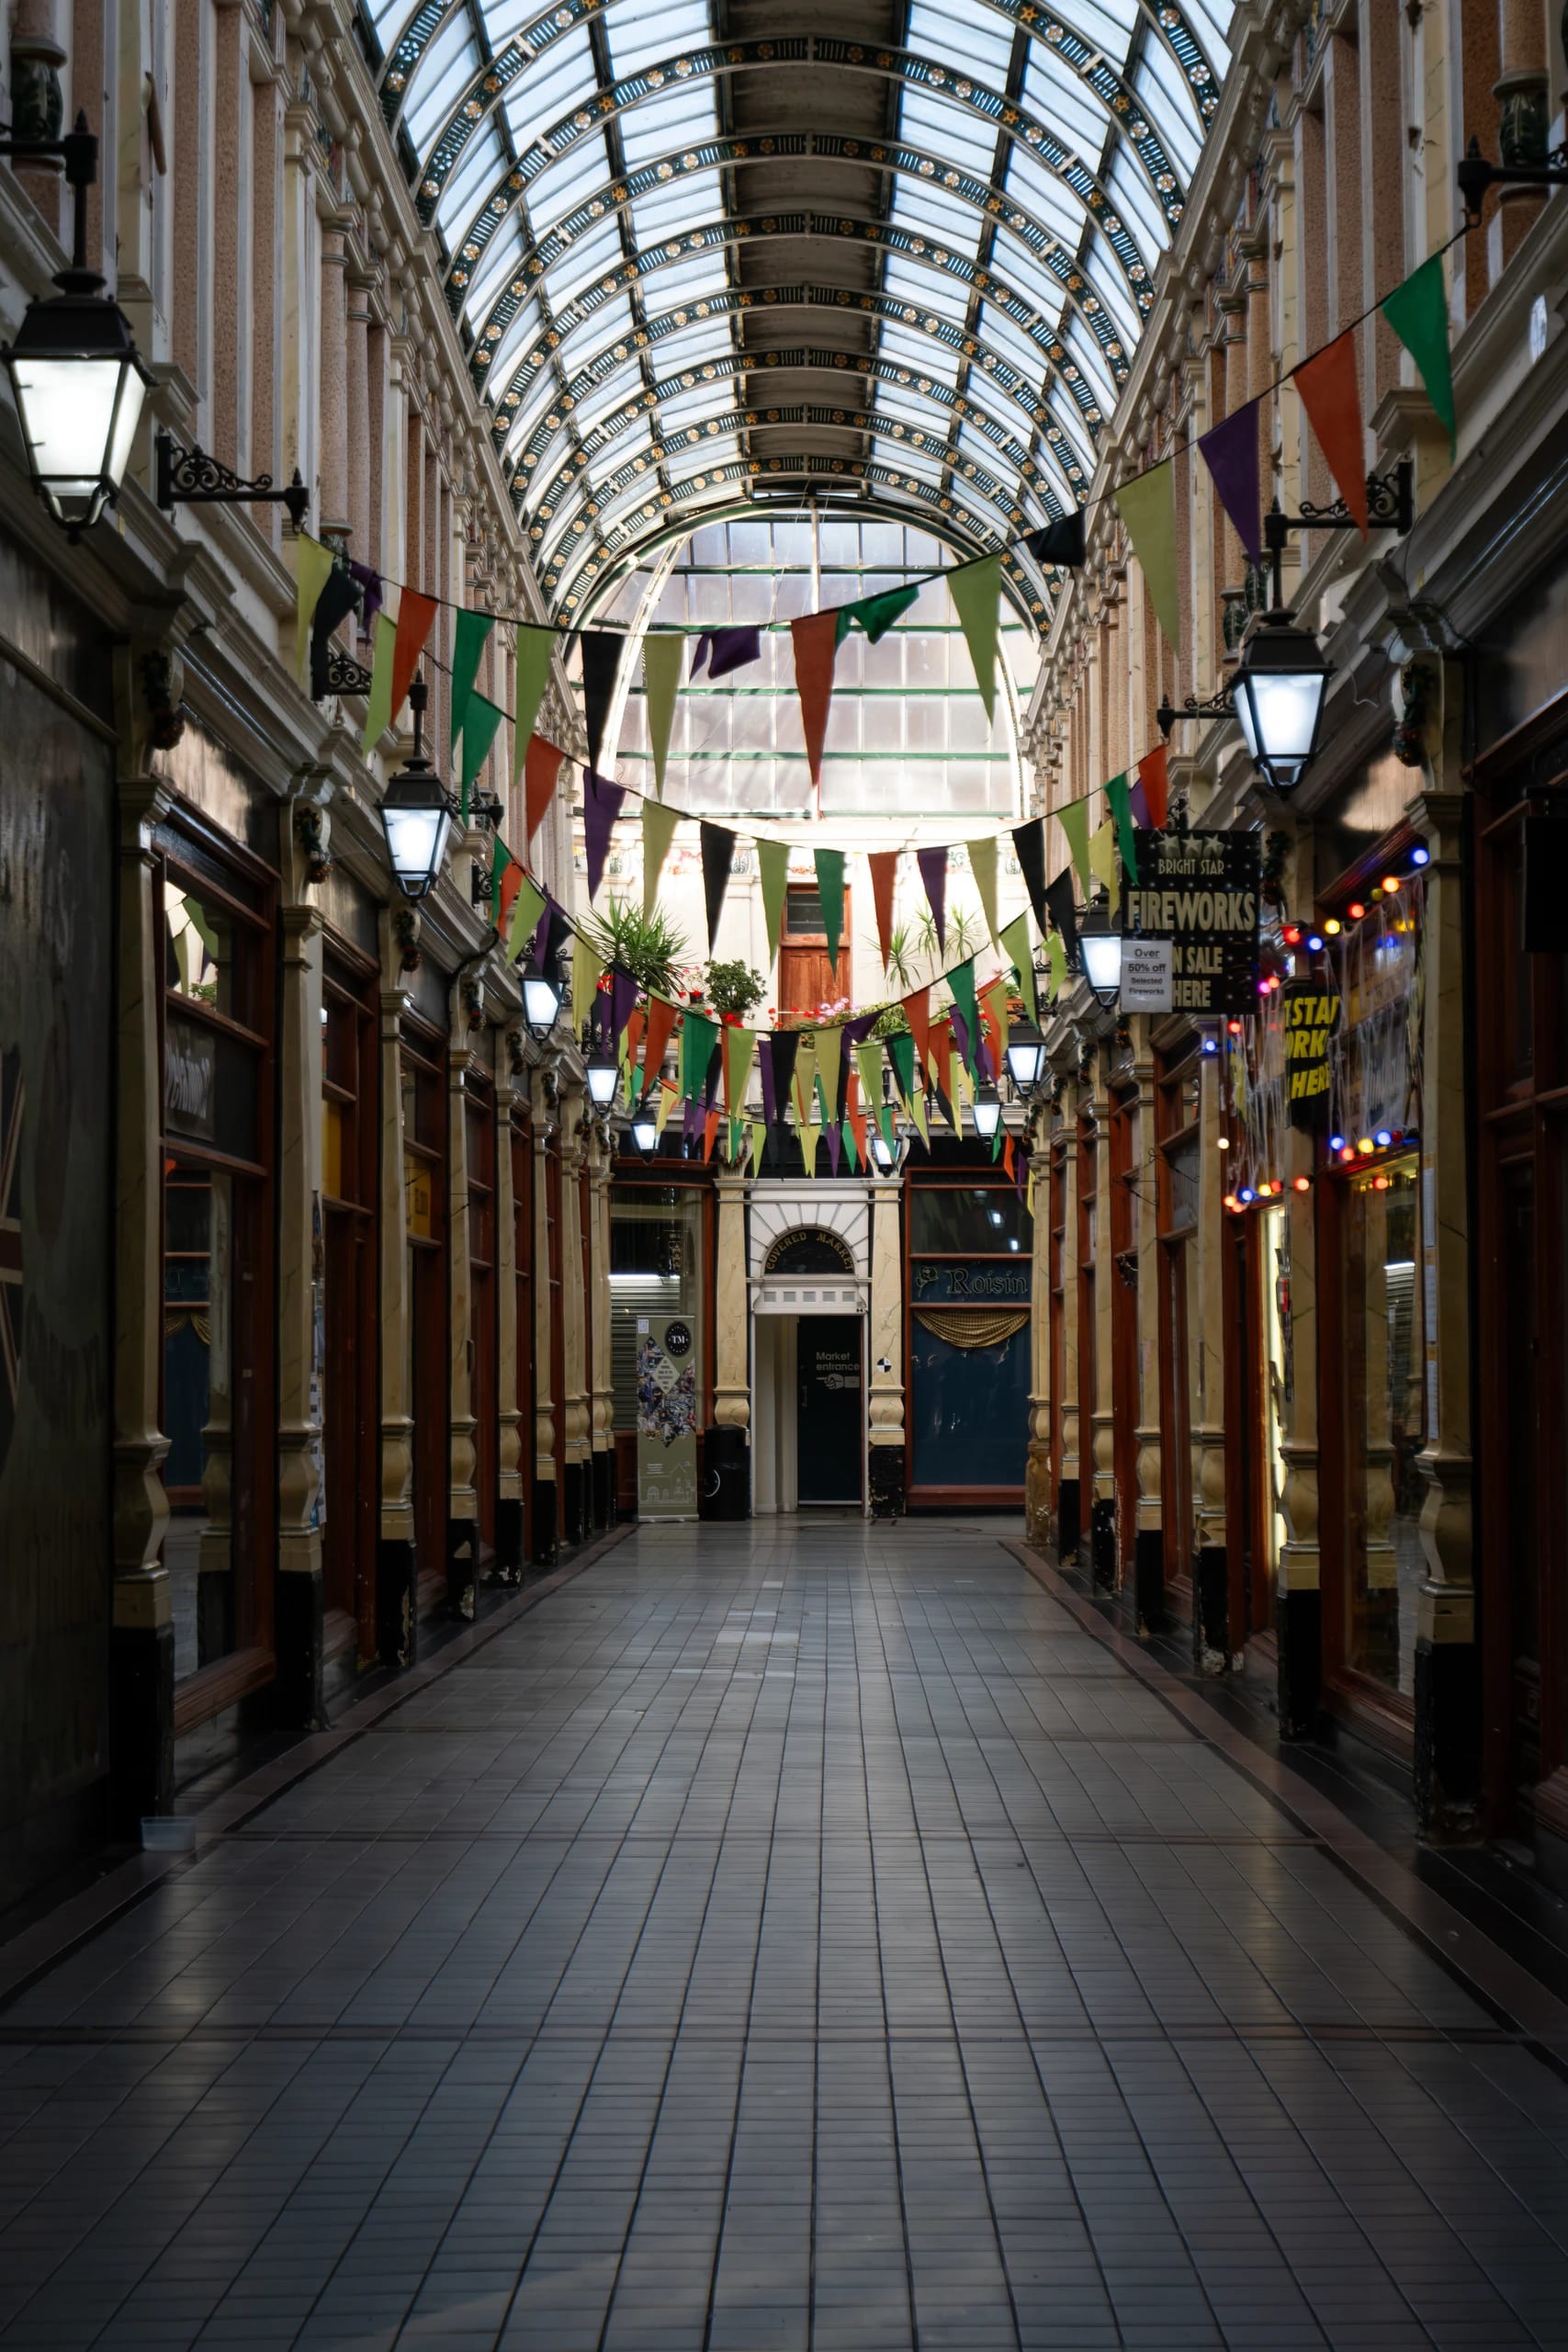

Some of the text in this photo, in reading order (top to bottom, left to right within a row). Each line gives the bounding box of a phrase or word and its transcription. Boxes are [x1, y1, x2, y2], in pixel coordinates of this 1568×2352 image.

[1158, 858, 1224, 875] BRIGHT STAR
[1127, 891, 1256, 932] FIREWORKS
[1134, 948, 1160, 957] Over
[1172, 946, 1224, 975] N SALE
[1128, 963, 1167, 974] 50% off
[1131, 977, 1163, 985] Selected
[1173, 979, 1212, 1007] HERE
[766, 1231, 853, 1270] COVERED MARKET
[671, 1335, 685, 1344] TM
[816, 1351, 851, 1361] Market
[816, 1362, 861, 1372] entrance
